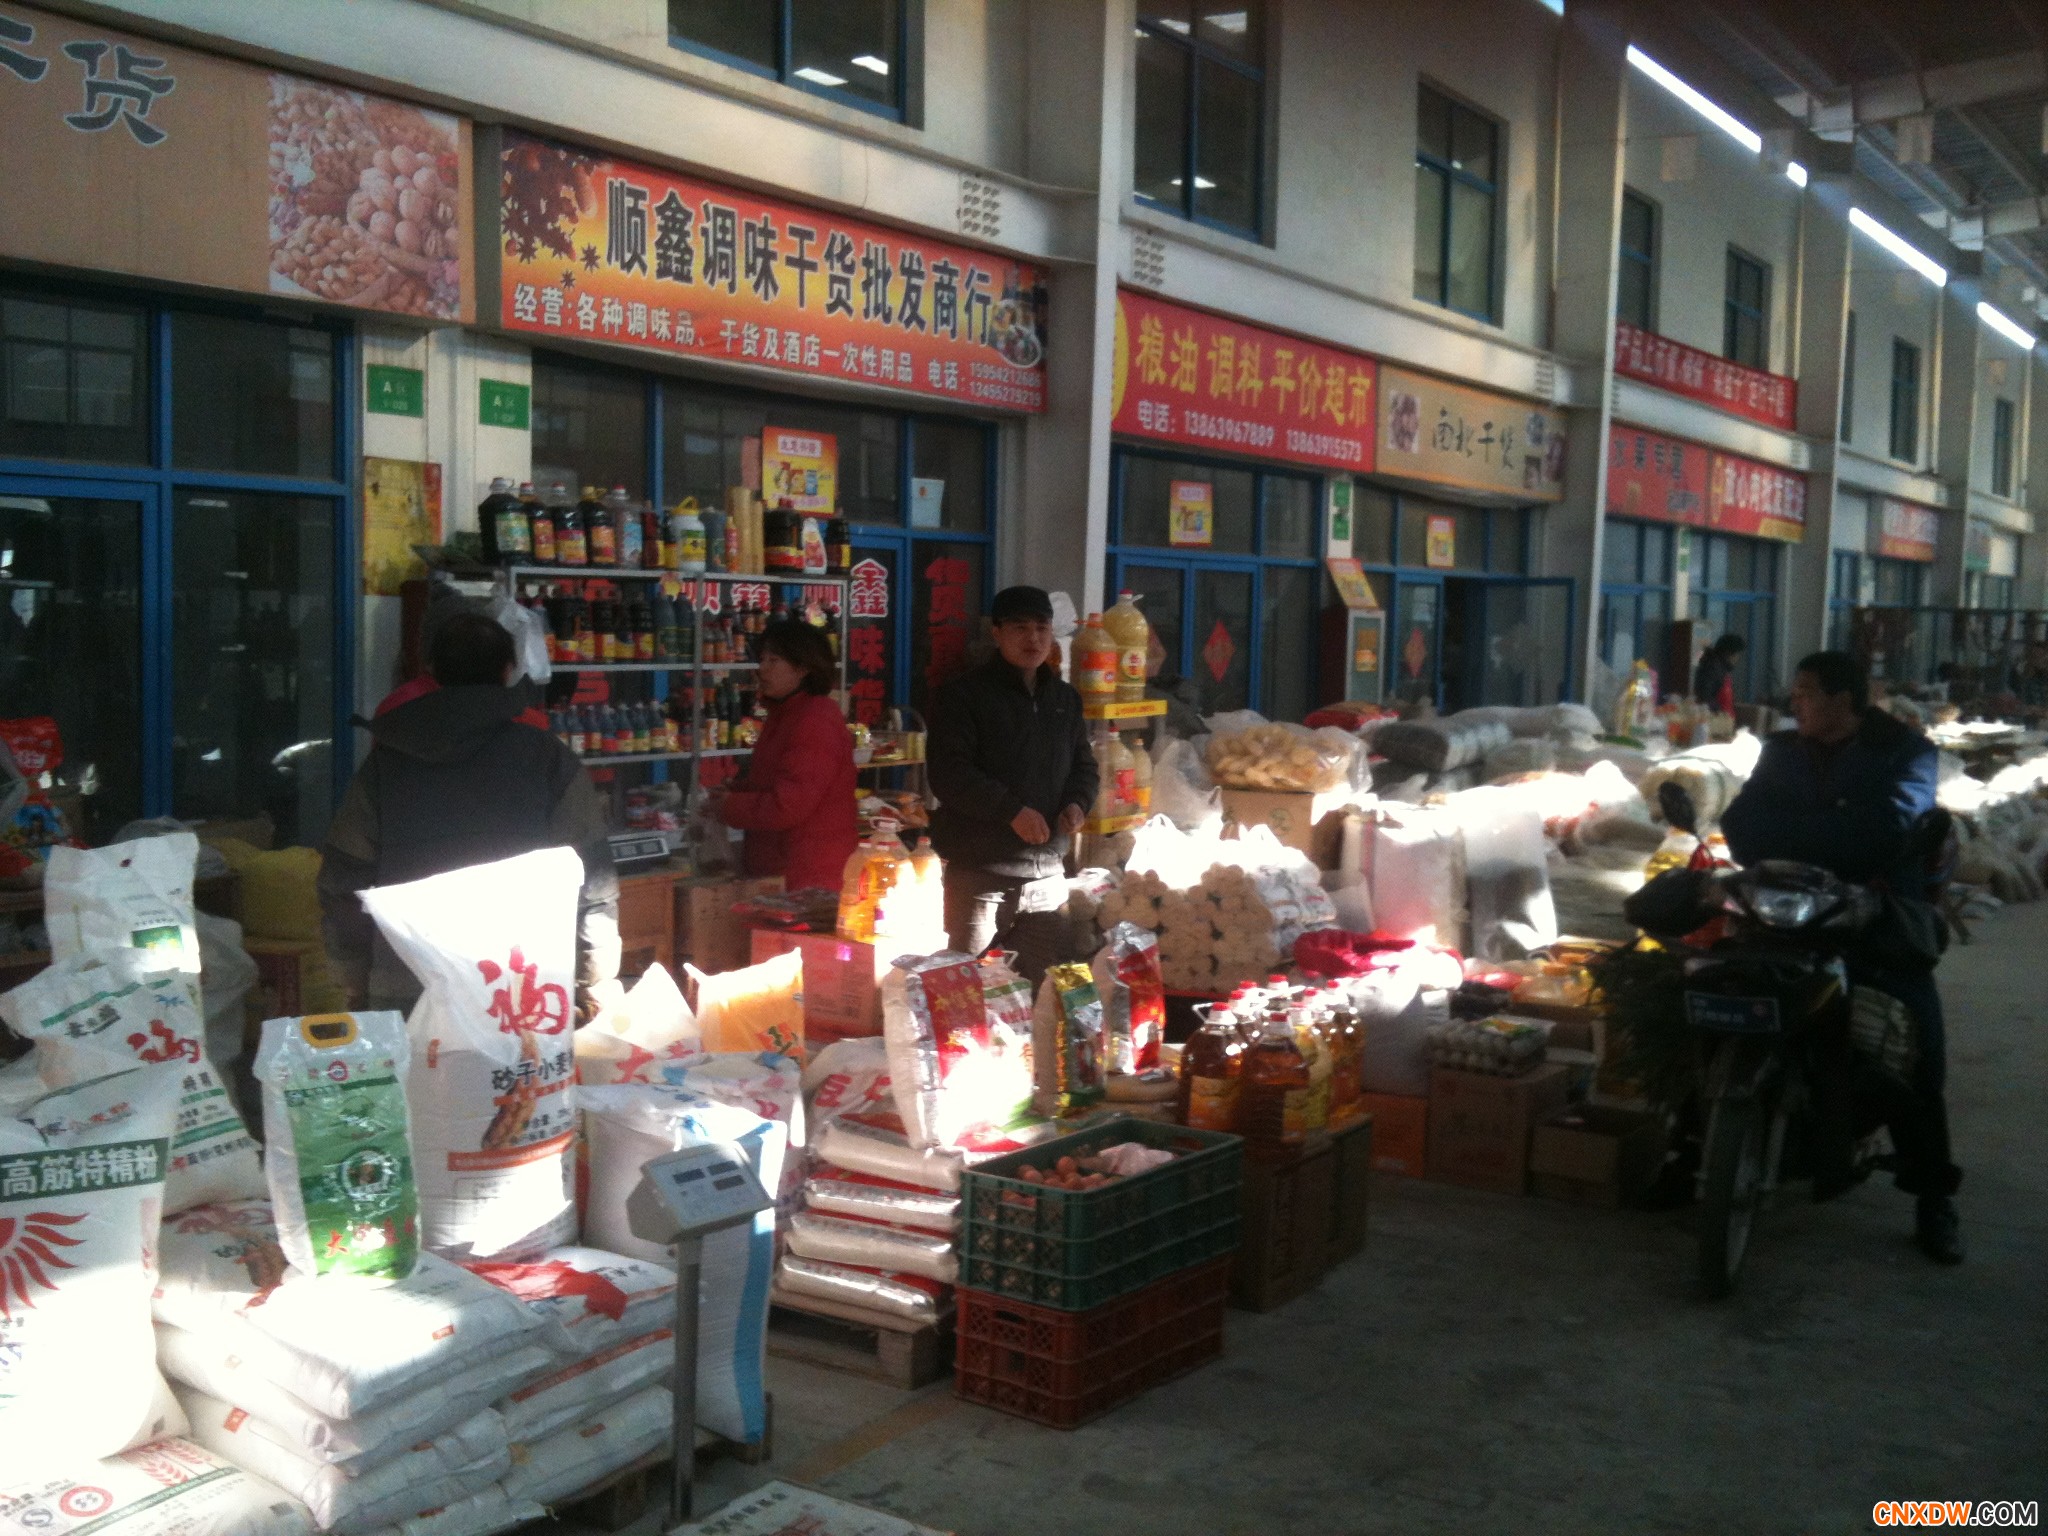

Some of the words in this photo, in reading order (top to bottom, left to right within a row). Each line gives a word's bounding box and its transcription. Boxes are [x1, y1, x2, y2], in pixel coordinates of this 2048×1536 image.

[605, 177, 993, 349] 顺鑫调味干货批发商行
[1, 1143, 159, 1197] 高筋特精粉
